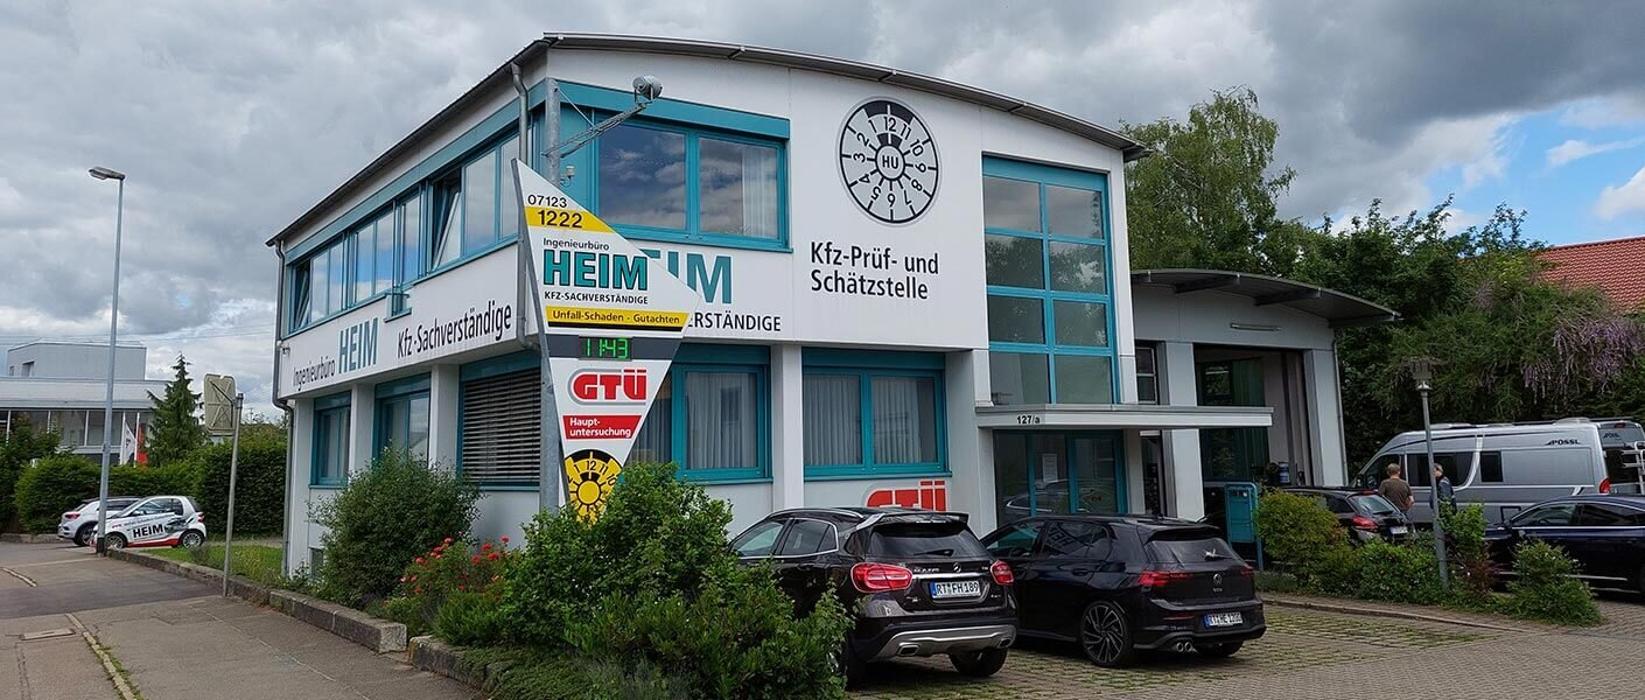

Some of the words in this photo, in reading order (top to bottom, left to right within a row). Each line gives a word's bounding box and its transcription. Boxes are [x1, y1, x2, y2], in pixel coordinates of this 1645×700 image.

[868, 120, 877, 133] 1
[884, 117, 897, 132] 12
[901, 124, 912, 140] 11
[857, 133, 870, 147] 2
[910, 139, 924, 157] 10
[853, 153, 866, 163] 3
[882, 155, 899, 169] HU
[915, 163, 927, 173] 9
[859, 174, 870, 184] 4
[911, 179, 923, 191] 8
[871, 186, 882, 200] 5
[887, 193, 896, 207] 6
[904, 190, 912, 205] 7
[527, 194, 568, 208] 07123
[538, 210, 583, 229] 1222
[543, 238, 610, 251] Ingenieurbüro
[811, 242, 897, 270] Kfz-Prüf-
[904, 253, 939, 275] und
[543, 249, 648, 291] HEIM
[811, 269, 928, 299] Schätzstelle
[544, 291, 649, 305] KFZ-SACHVERSTÄNDIGE
[552, 310, 625, 323] Unfall-Schaden
[633, 314, 681, 325] Gutachten
[293, 356, 336, 391] Ingenieurbüro
[338, 317, 379, 374] HEIM
[397, 300, 512, 359] Kfz-Sachverständige
[586, 338, 629, 359] 11:43
[572, 368, 648, 401] GTÜ
[570, 417, 601, 428] Haupt-
[1016, 415, 1041, 425] 127/a
[569, 429, 632, 440] untersuchung
[586, 460, 597, 471] 12
[133, 524, 164, 539] HEIM
